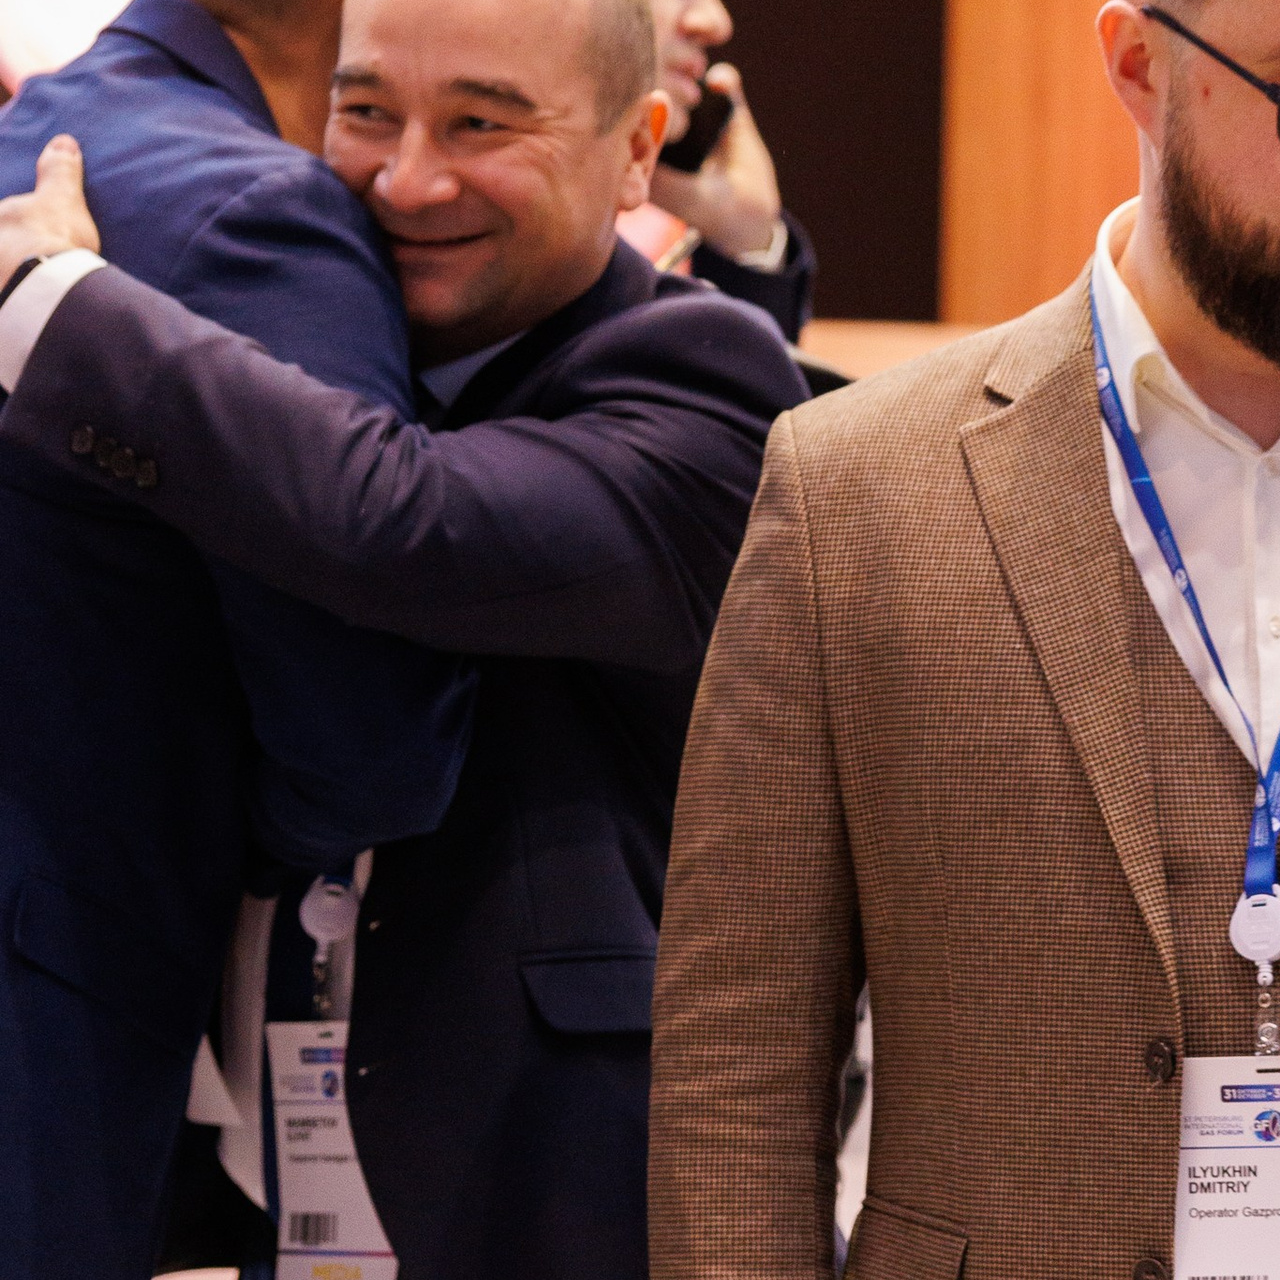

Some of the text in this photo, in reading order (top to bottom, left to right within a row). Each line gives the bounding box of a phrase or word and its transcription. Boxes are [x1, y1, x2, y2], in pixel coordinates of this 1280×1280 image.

[1223, 1089, 1237, 1100] 31
[1187, 1165, 1259, 1179] ILYUKHIN
[1188, 1180, 1251, 1194] DMITRIY
[1188, 1207, 1239, 1220] Operator
